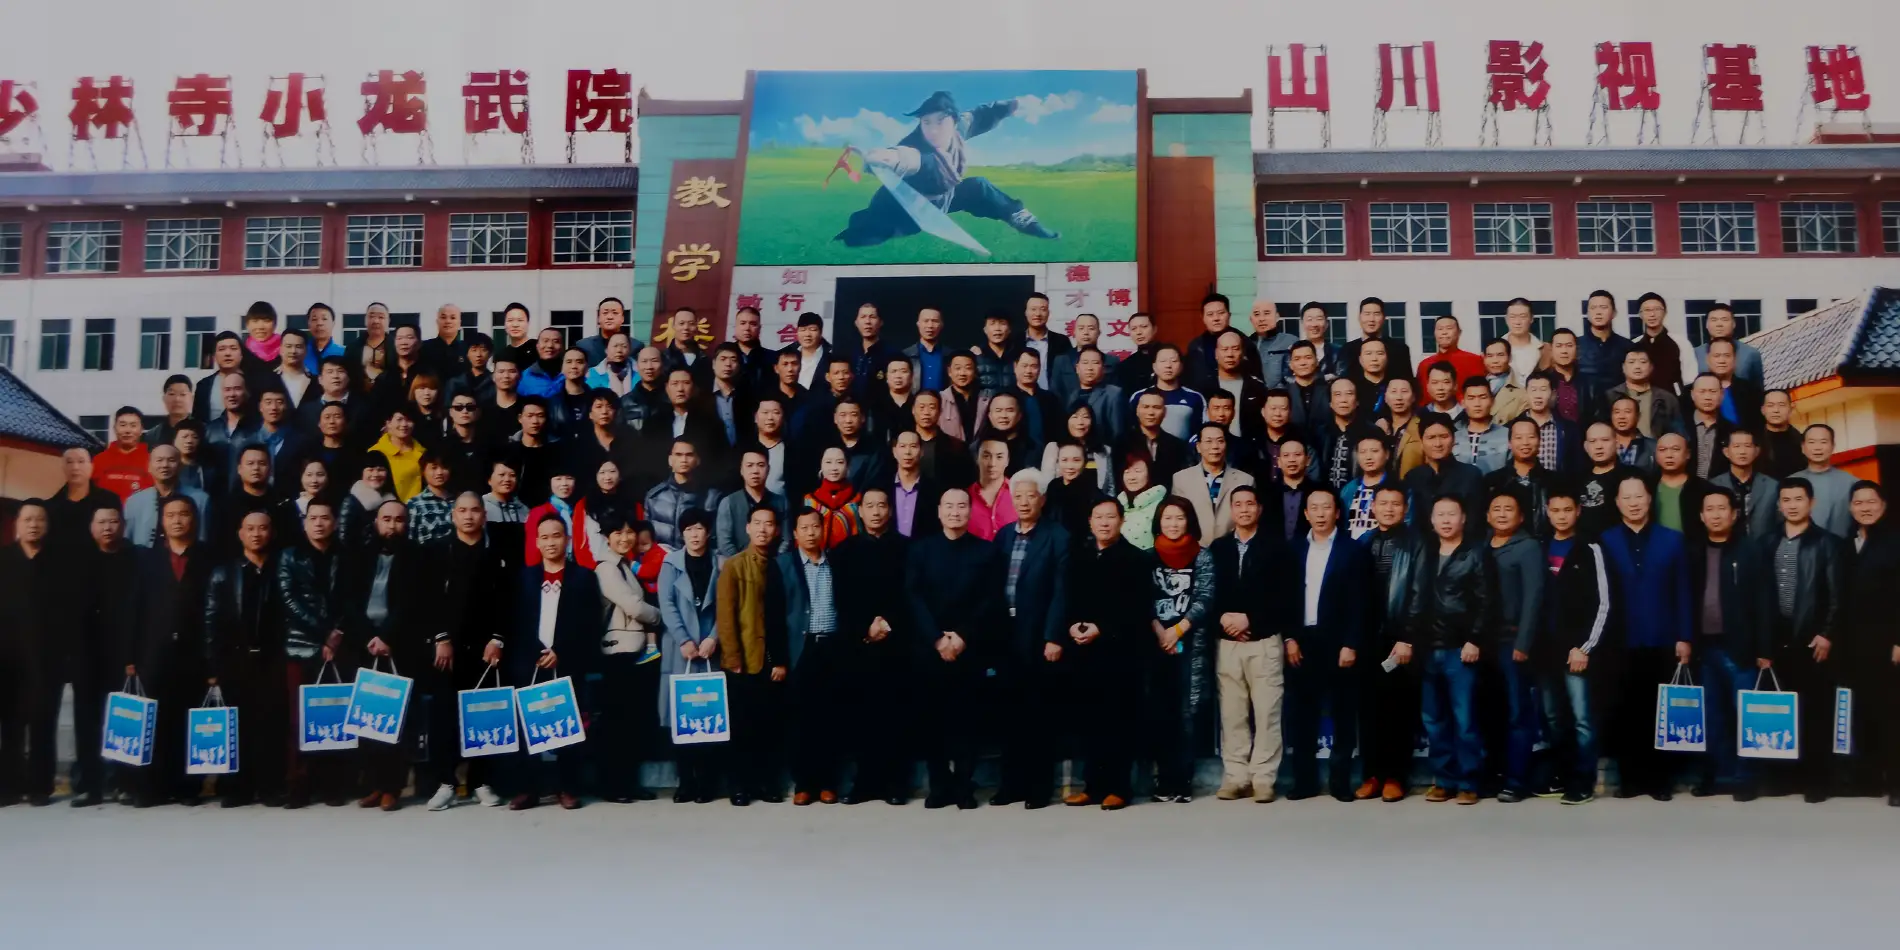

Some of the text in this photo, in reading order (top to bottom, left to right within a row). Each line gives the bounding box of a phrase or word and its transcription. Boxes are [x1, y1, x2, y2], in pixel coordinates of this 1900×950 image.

[0, 68, 634, 141] 少林寺小龙武院
[1267, 40, 1871, 112] 山川影视基地
